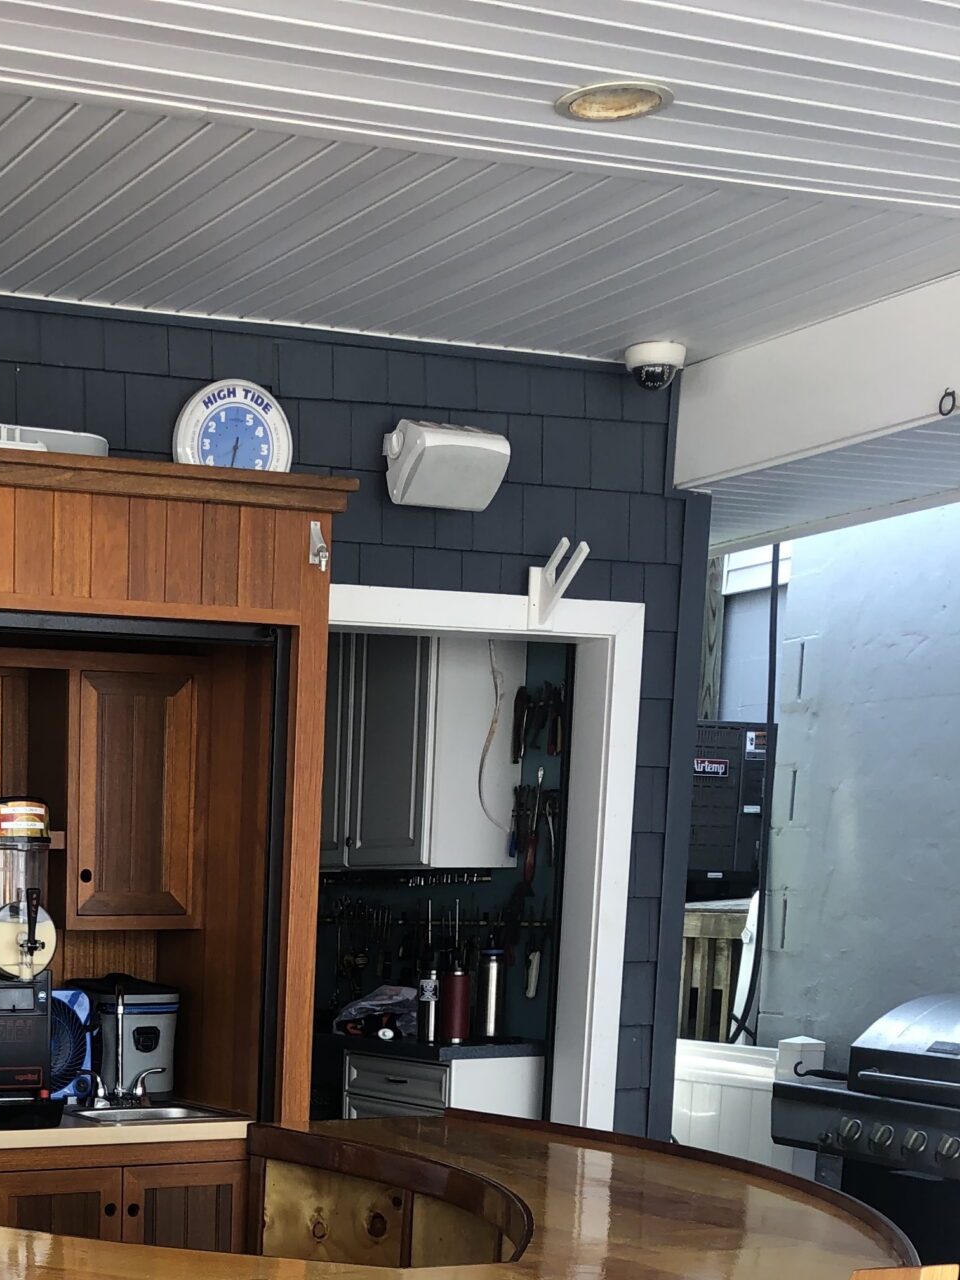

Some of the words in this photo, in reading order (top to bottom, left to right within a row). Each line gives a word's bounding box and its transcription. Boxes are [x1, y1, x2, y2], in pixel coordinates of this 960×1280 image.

[203, 387, 237, 410] HIGH
[243, 388, 273, 415] TIDE
[220, 411, 227, 423] 1
[246, 414, 255, 426] 5
[208, 421, 217, 433] 2
[255, 426, 265, 438] 4
[202, 438, 211, 450] 3
[260, 444, 269, 456] 3
[205, 455, 215, 466] 4
[254, 459, 264, 470] 2
